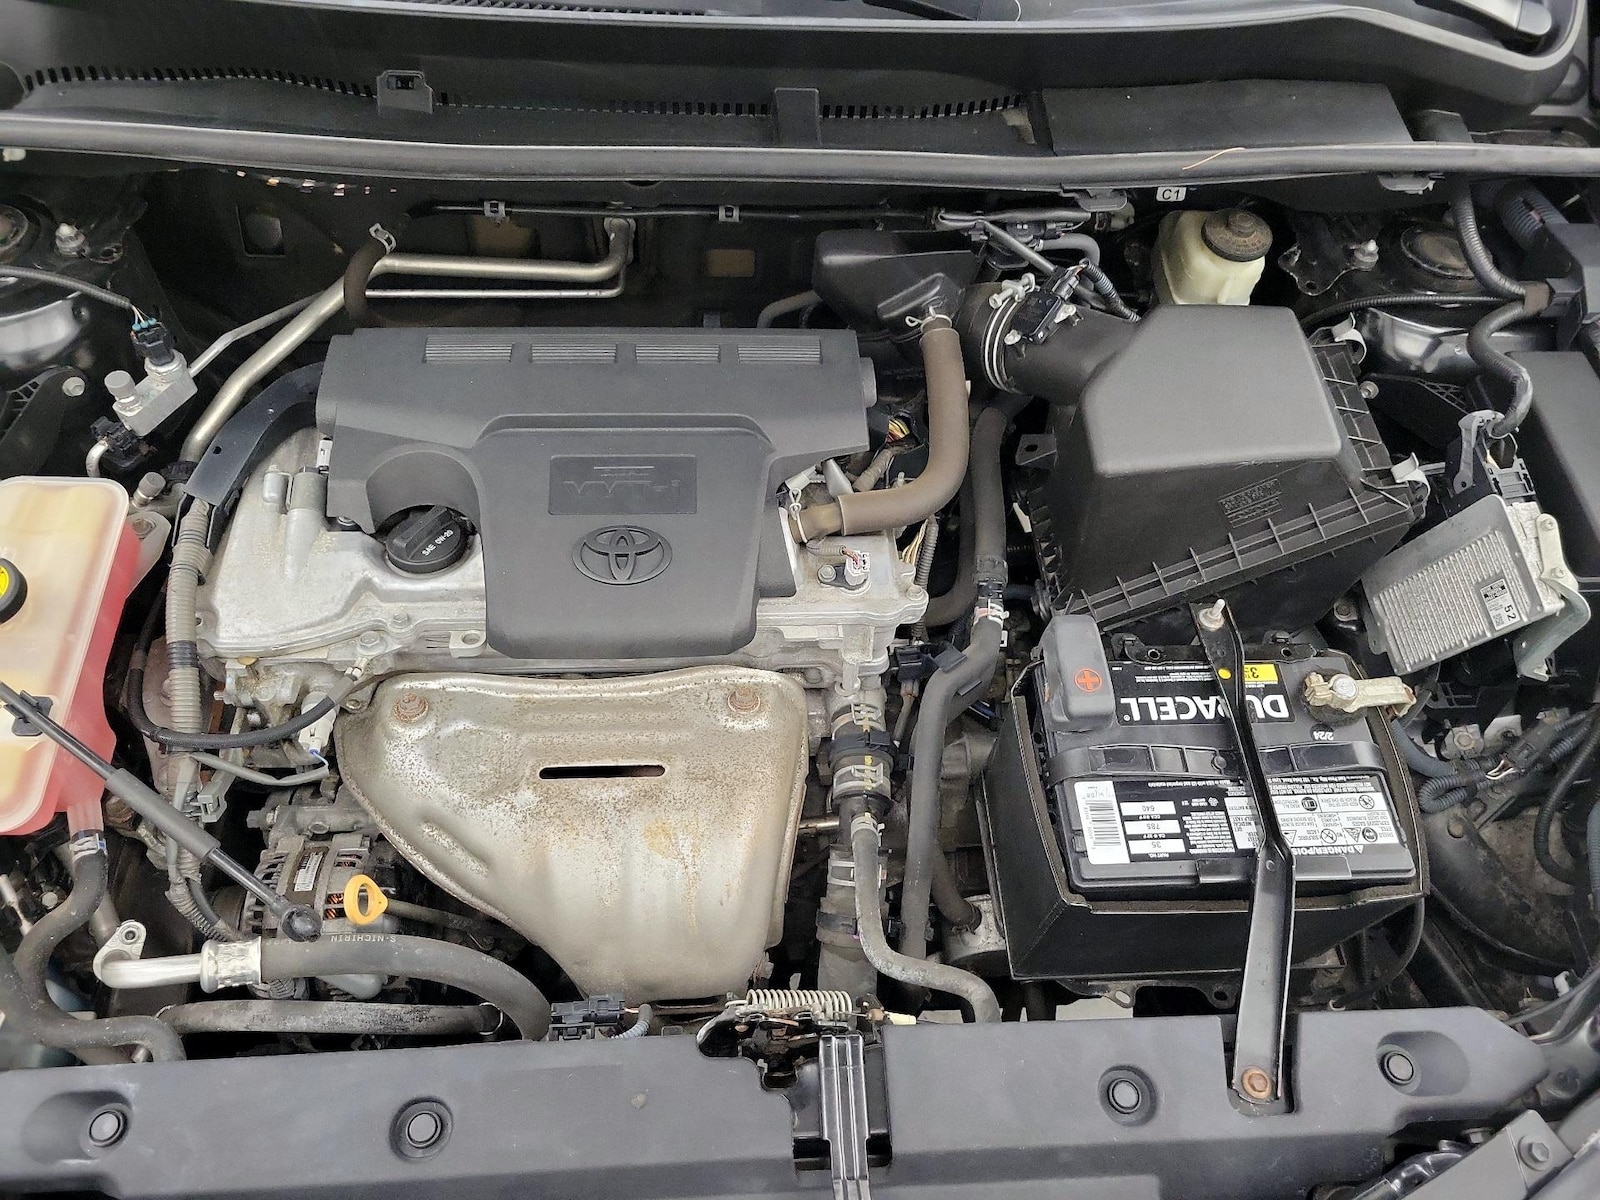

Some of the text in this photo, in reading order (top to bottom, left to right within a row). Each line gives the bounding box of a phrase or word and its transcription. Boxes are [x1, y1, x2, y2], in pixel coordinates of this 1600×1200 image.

[1162, 188, 1181, 201] C1
[421, 544, 438, 557] SAE
[1504, 604, 1518, 623] 52
[1249, 666, 1259, 679] 3
[1151, 841, 1162, 849] 35
[1290, 845, 1355, 856] DANGER/POIS
